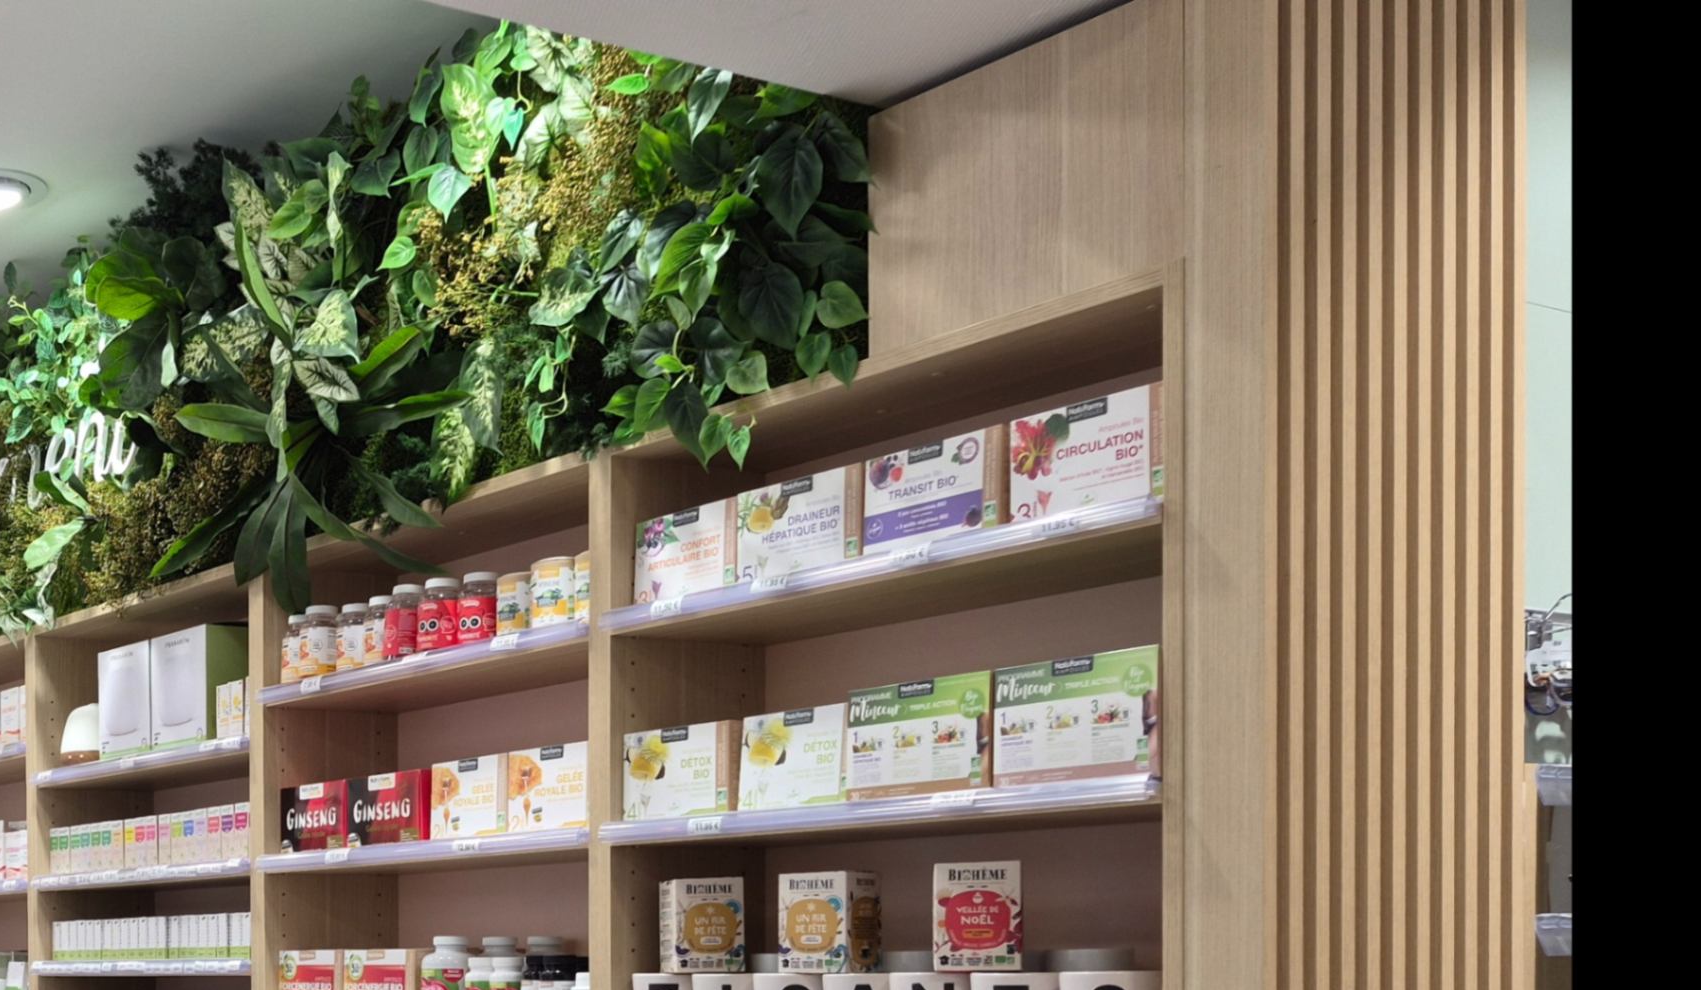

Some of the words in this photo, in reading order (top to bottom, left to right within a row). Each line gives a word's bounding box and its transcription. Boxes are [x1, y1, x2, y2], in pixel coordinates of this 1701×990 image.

[1056, 429, 1144, 460] CIRCULATION
[888, 481, 933, 502] TRANSIT
[787, 505, 840, 526] DRAINEUR
[680, 534, 720, 553] CONFORT
[762, 523, 817, 544] HÉPATIQUE
[648, 551, 702, 572] ARTICULAIRE
[996, 678, 1055, 702] Minceur
[849, 700, 901, 723] Minceur
[681, 754, 713, 769] DÉTOX
[693, 769, 710, 780] BIO
[287, 807, 336, 830] GINSENG
[353, 798, 410, 824] GINSENG
[960, 914, 995, 925] NOËL
